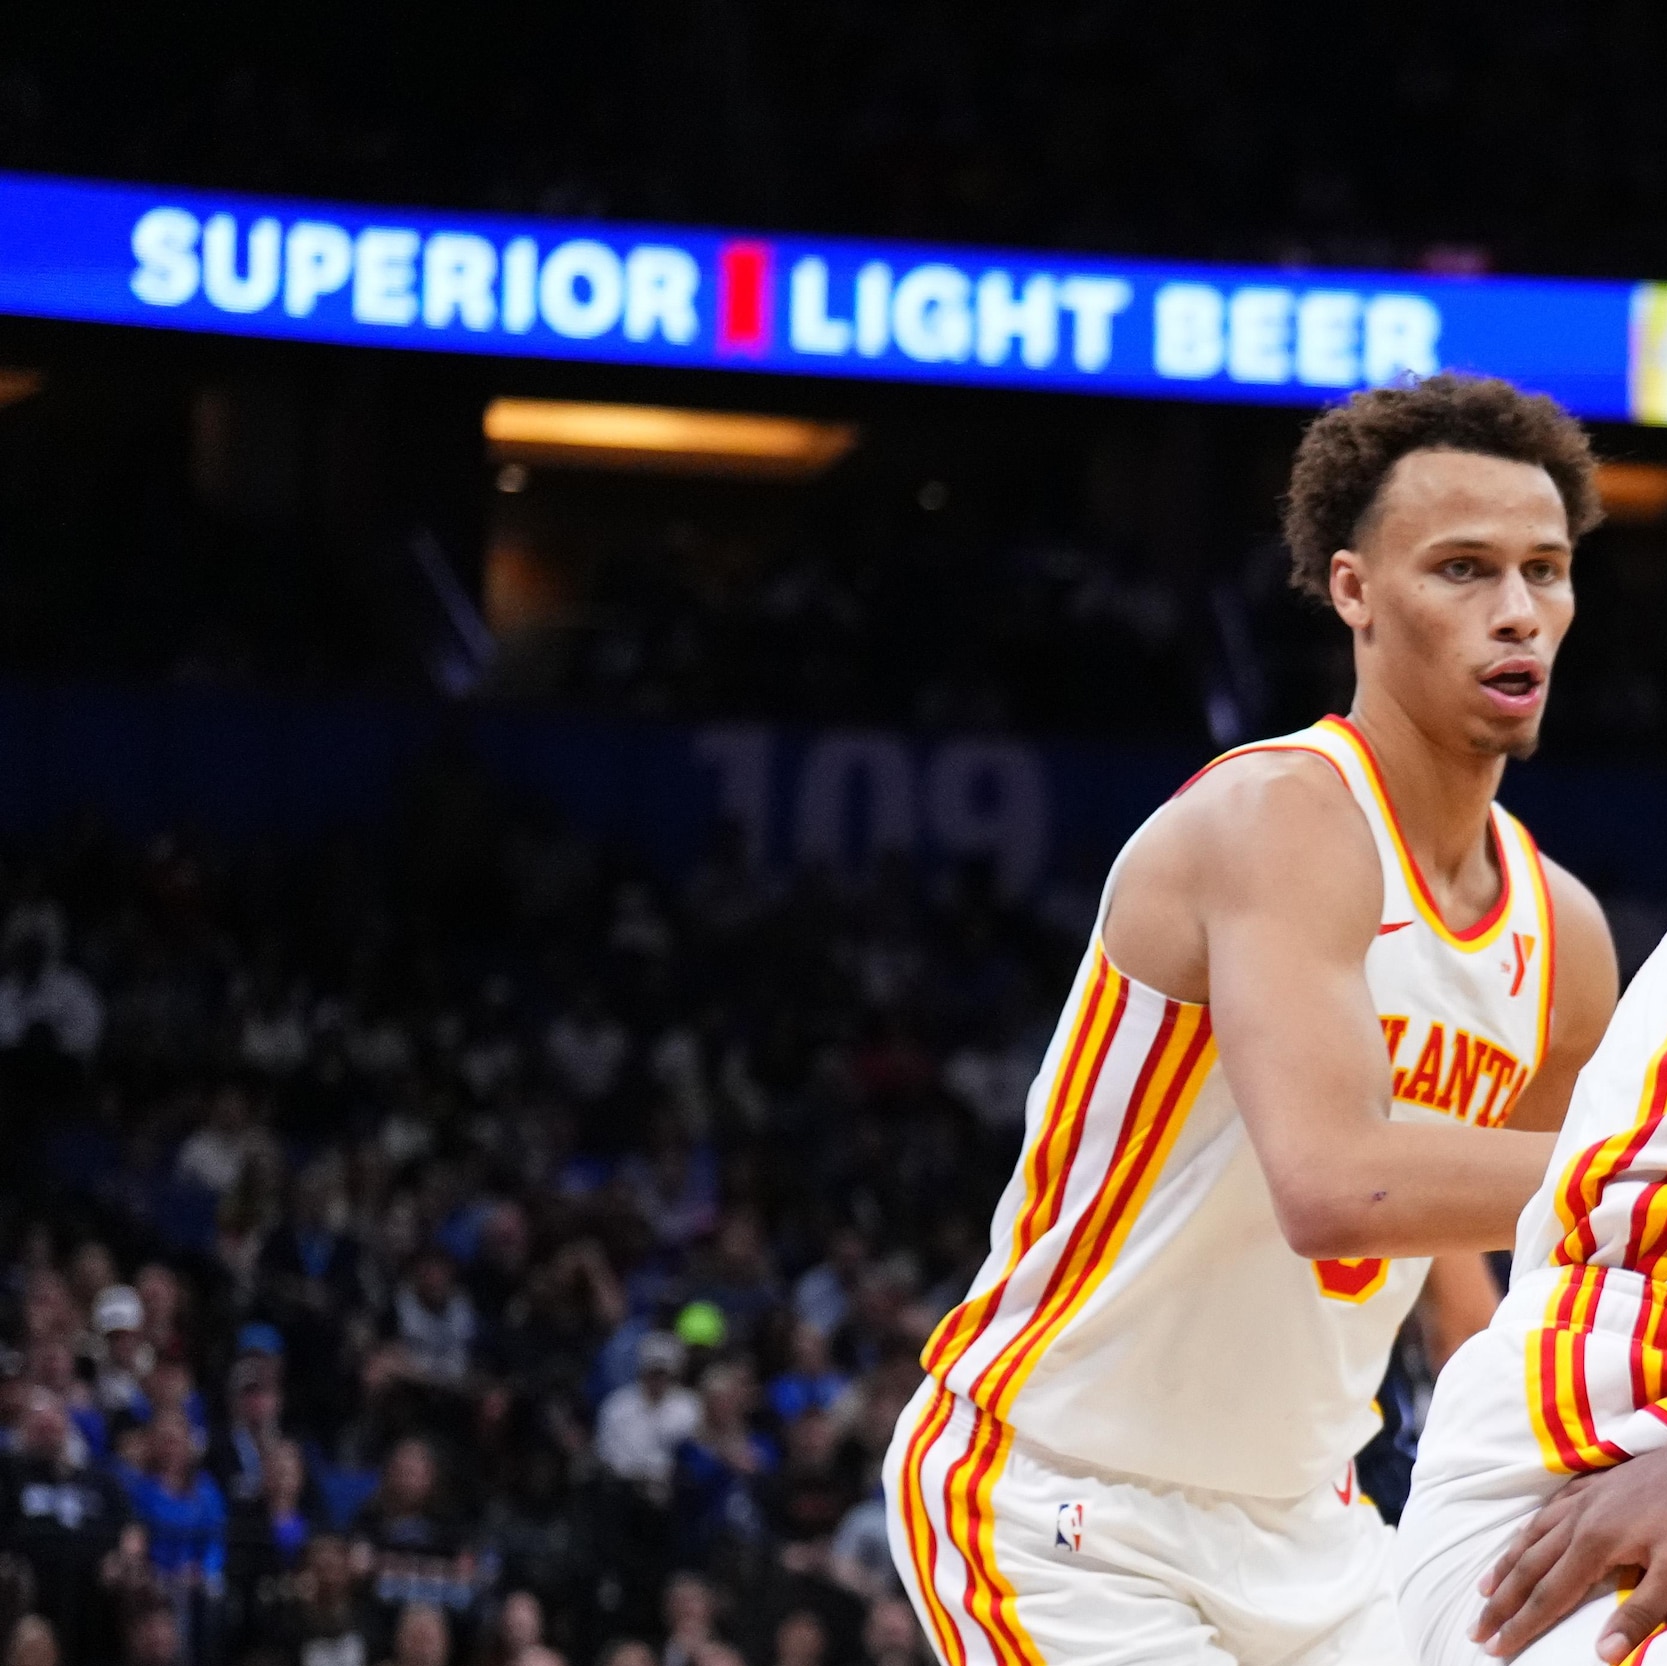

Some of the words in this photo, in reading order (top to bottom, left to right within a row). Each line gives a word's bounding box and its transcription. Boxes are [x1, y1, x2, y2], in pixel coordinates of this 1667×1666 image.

[130, 207, 699, 346] SUPERIOR
[789, 257, 1133, 374] LIGHT
[1153, 281, 1443, 391] BEER
[694, 718, 1053, 905] 109
